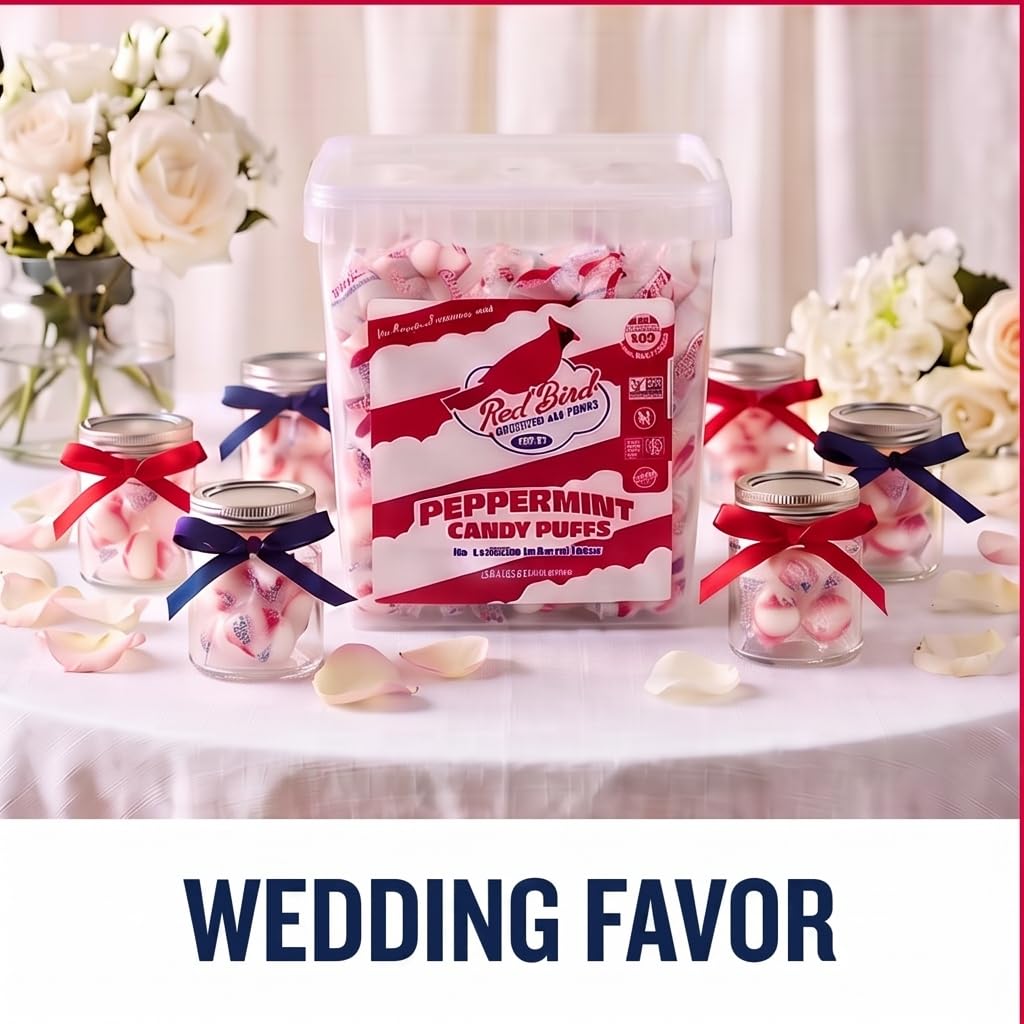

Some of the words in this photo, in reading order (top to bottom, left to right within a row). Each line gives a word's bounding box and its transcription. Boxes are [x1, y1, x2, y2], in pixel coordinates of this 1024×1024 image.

[480, 389, 533, 432] Red
[535, 370, 600, 415] Bird
[419, 489, 635, 526] PEPPERMINT
[447, 521, 531, 539] CANDY
[535, 521, 611, 538] PUFFS
